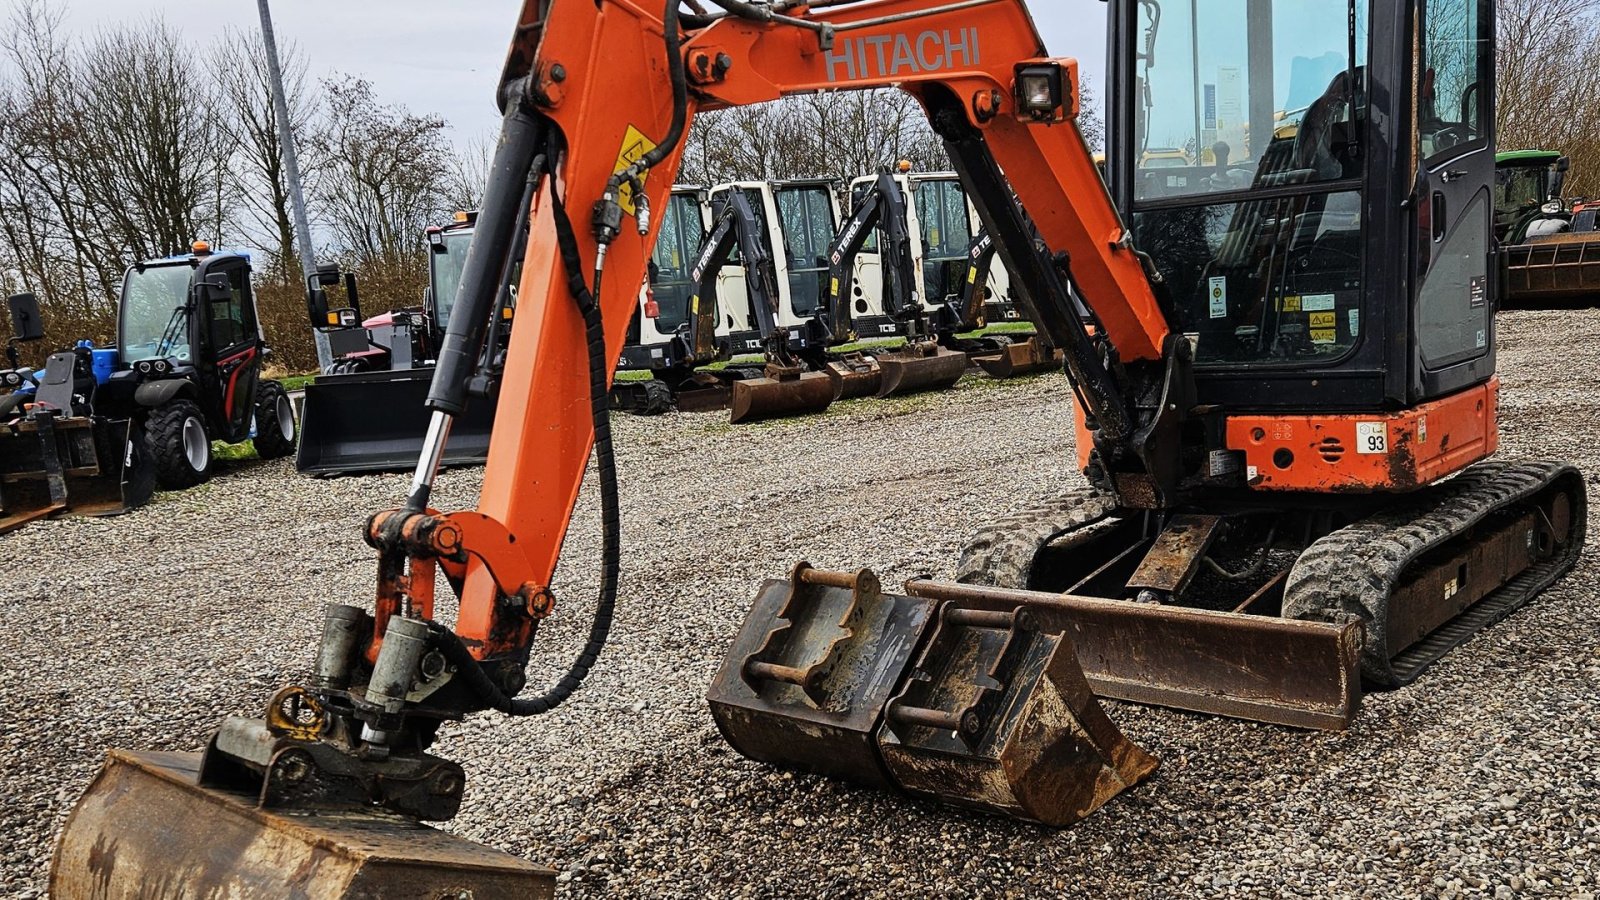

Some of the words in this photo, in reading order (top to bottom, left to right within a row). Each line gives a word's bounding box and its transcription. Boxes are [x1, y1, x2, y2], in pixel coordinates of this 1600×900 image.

[825, 27, 980, 81] HITACHI
[837, 217, 861, 253] TEREX
[697, 236, 717, 271] TEREX
[1368, 436, 1384, 451] 93
